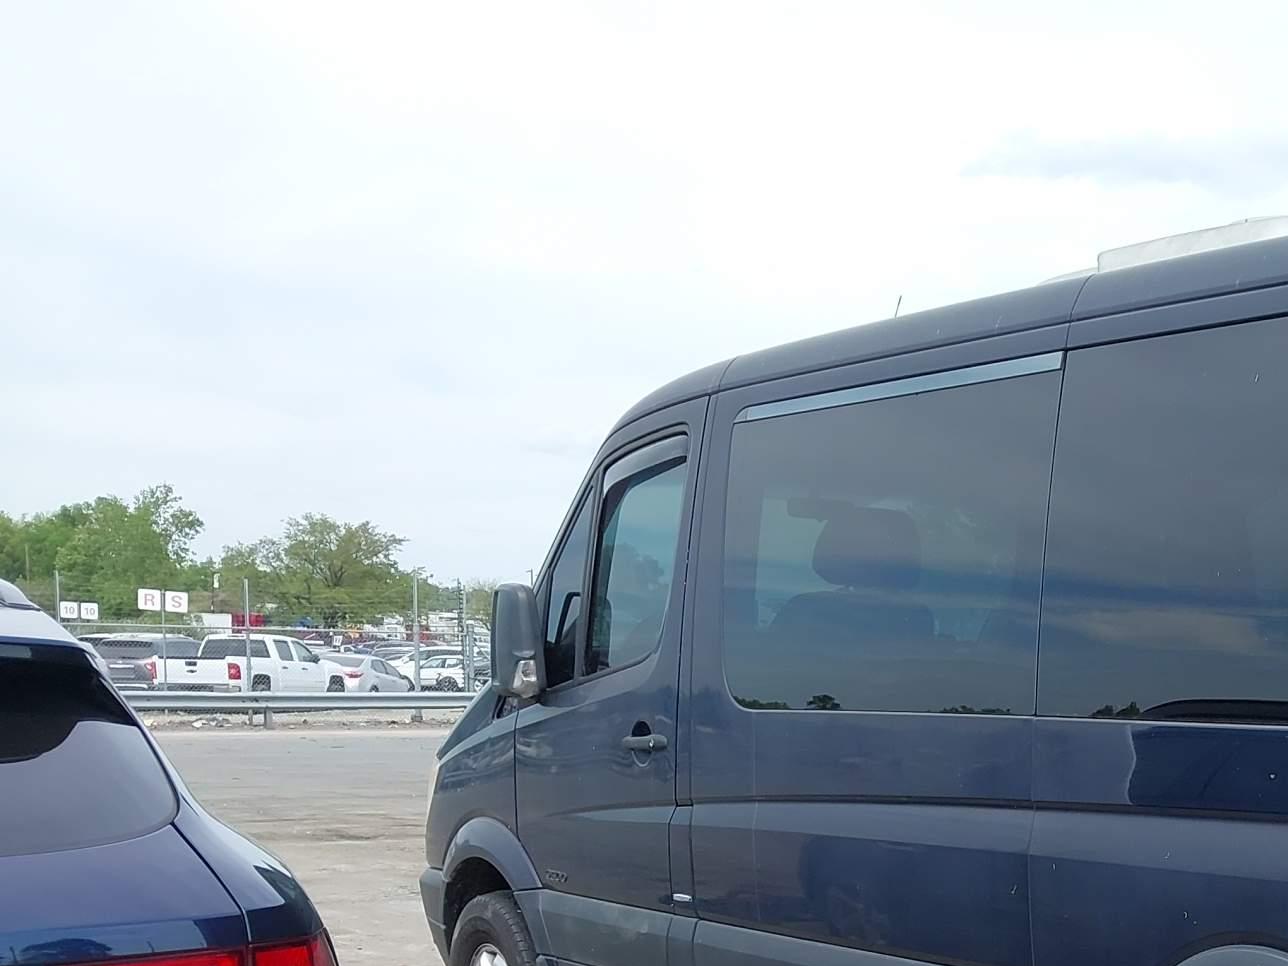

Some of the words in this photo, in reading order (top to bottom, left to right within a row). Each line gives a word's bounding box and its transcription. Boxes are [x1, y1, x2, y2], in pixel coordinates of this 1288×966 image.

[144, 593, 155, 607] R
[171, 595, 182, 608] S
[64, 606, 75, 615] 10
[85, 607, 96, 616] 10
